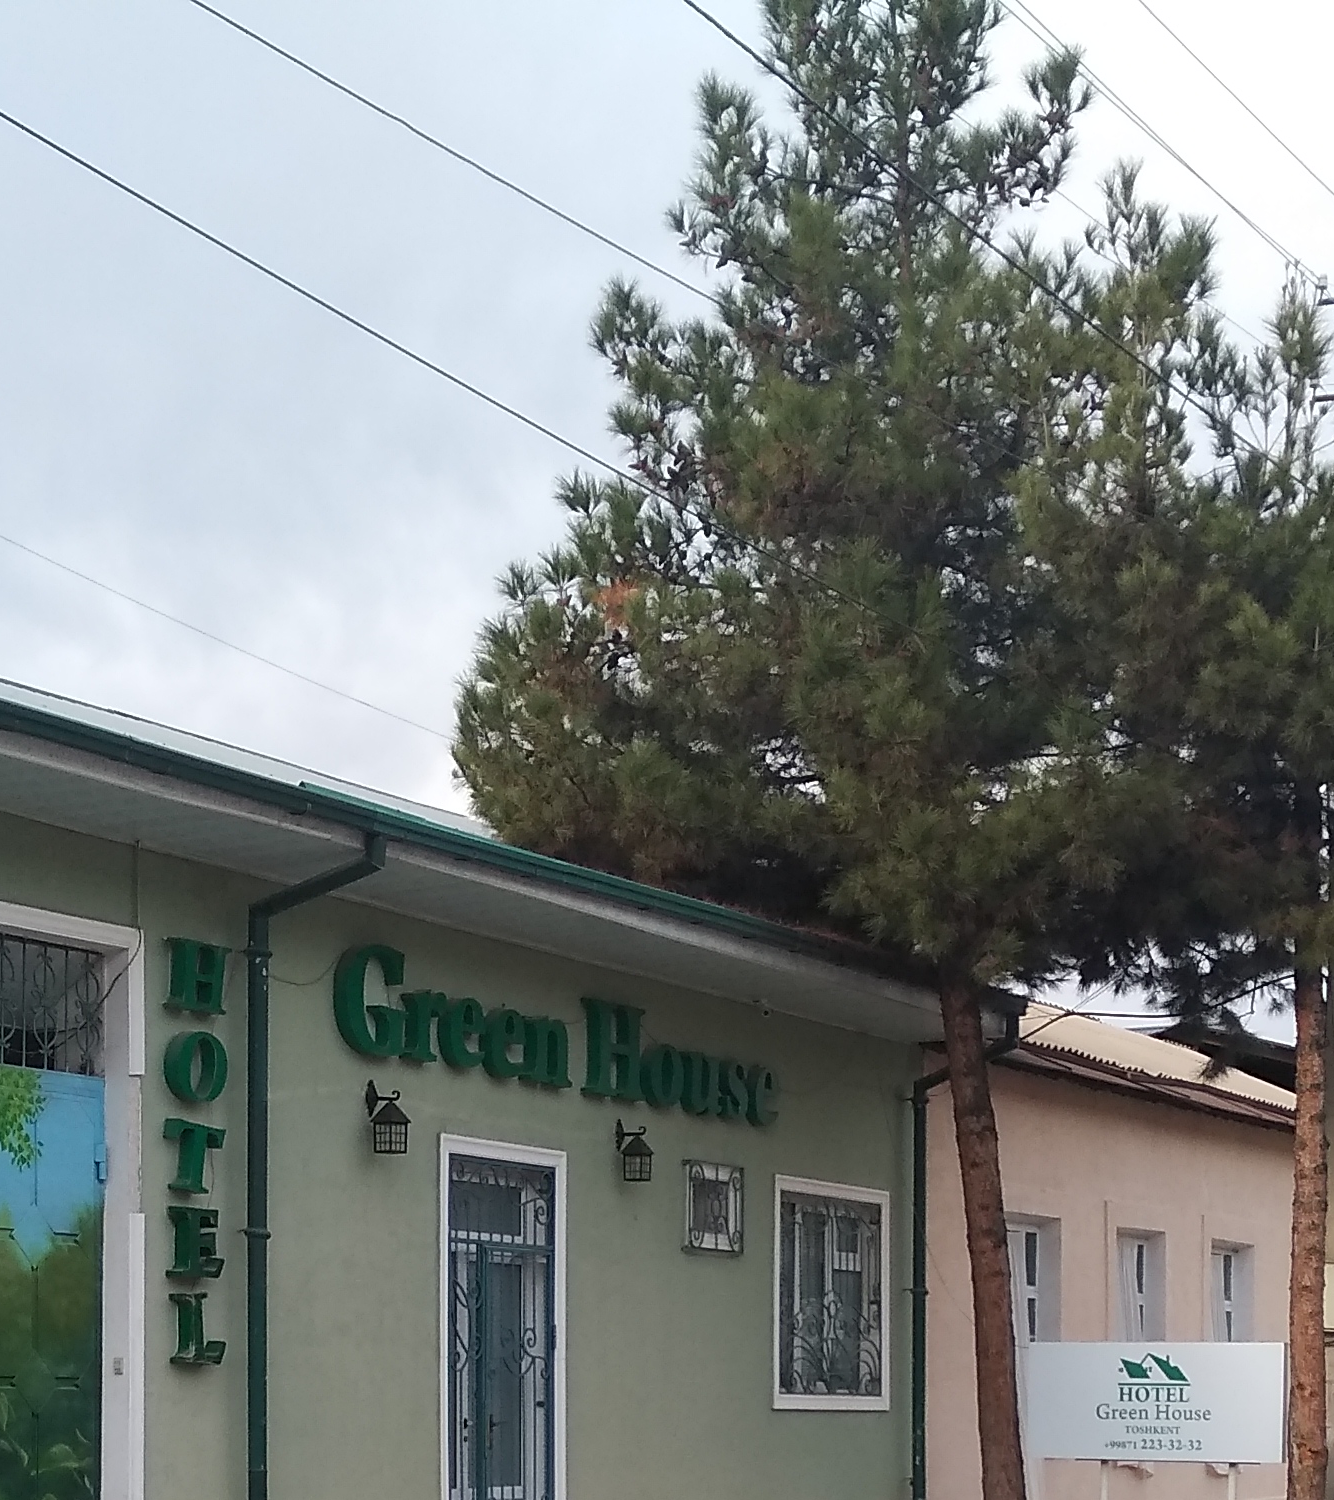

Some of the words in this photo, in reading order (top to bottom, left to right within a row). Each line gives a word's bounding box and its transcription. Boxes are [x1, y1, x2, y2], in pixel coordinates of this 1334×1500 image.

[332, 943, 573, 1088] Green
[580, 997, 779, 1127] House
[162, 937, 232, 1366] HOTEL
[1118, 1386, 1190, 1402] HOTEL
[1095, 1403, 1149, 1421] Green
[1155, 1404, 1212, 1421] House
[1125, 1425, 1180, 1435] TOSHKENT
[1140, 1438, 1202, 1451] 223-32-32
